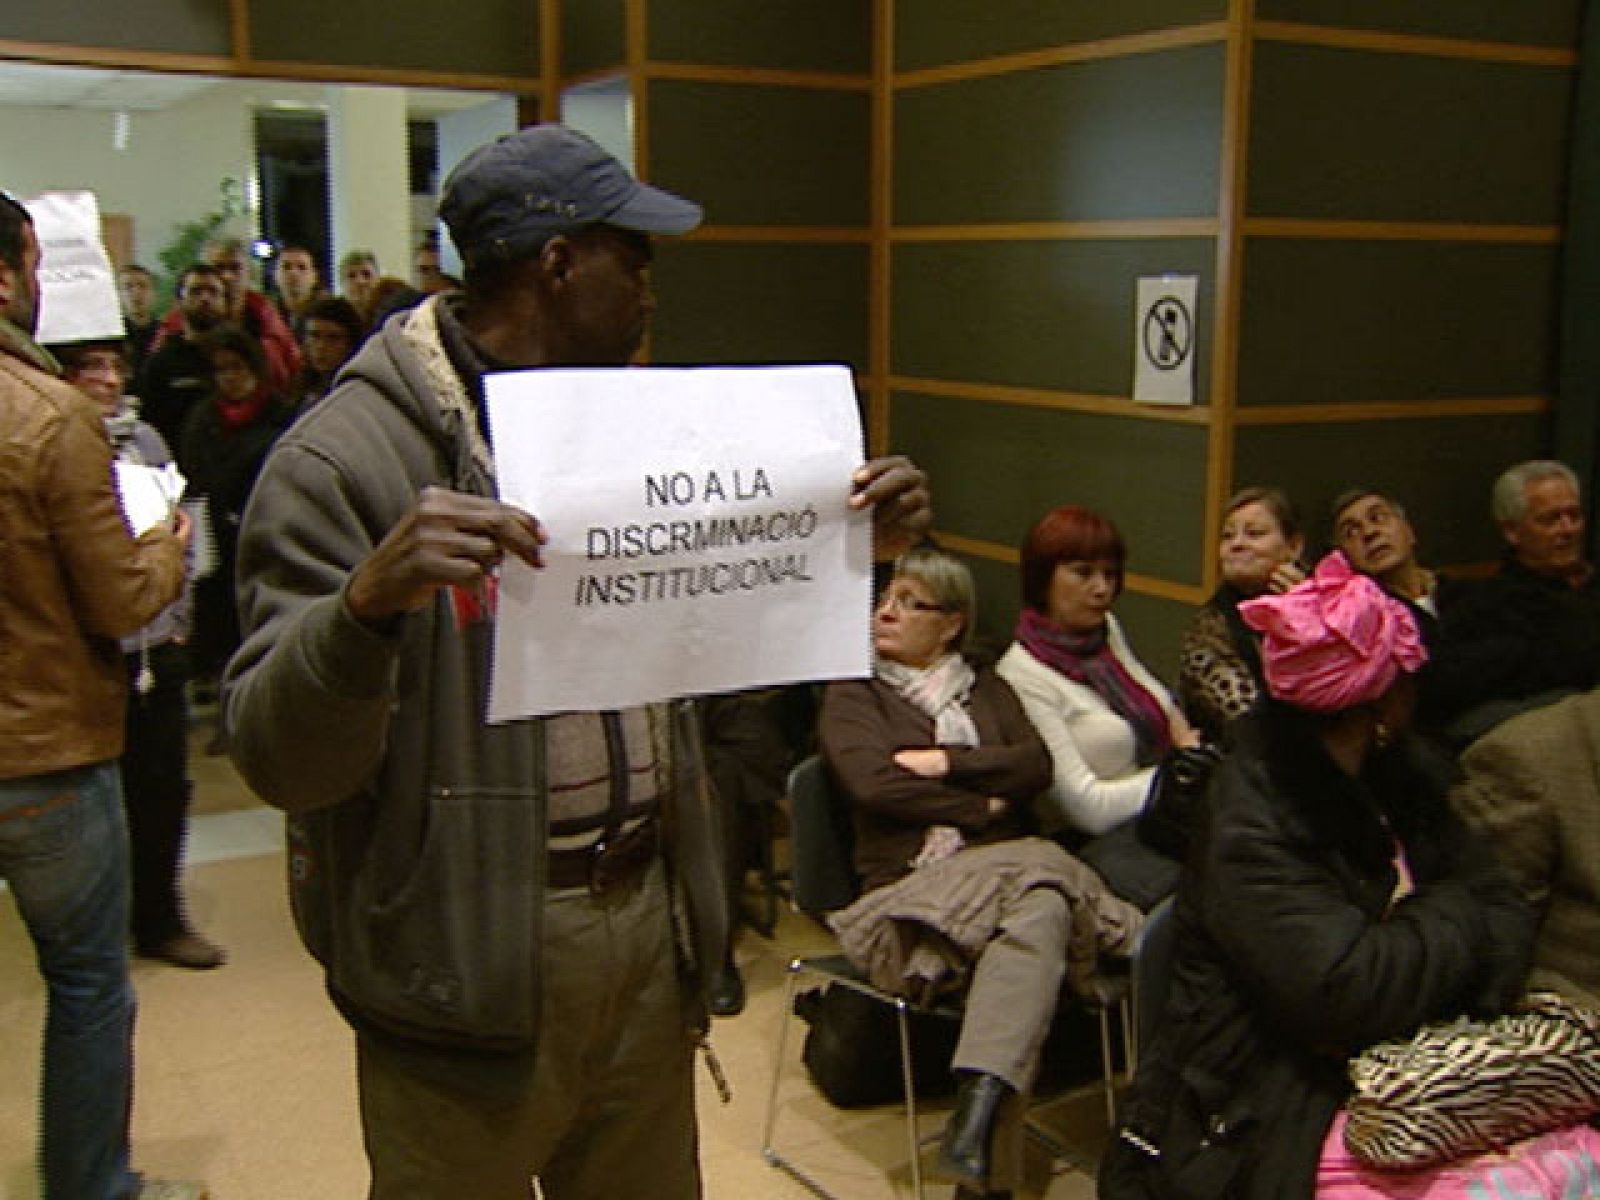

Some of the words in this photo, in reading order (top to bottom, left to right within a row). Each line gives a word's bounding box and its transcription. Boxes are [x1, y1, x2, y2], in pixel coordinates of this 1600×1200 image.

[645, 471, 695, 506] NO
[704, 470, 726, 501] A
[734, 467, 773, 500] LA
[575, 554, 814, 606] INSTITUCIONAL
